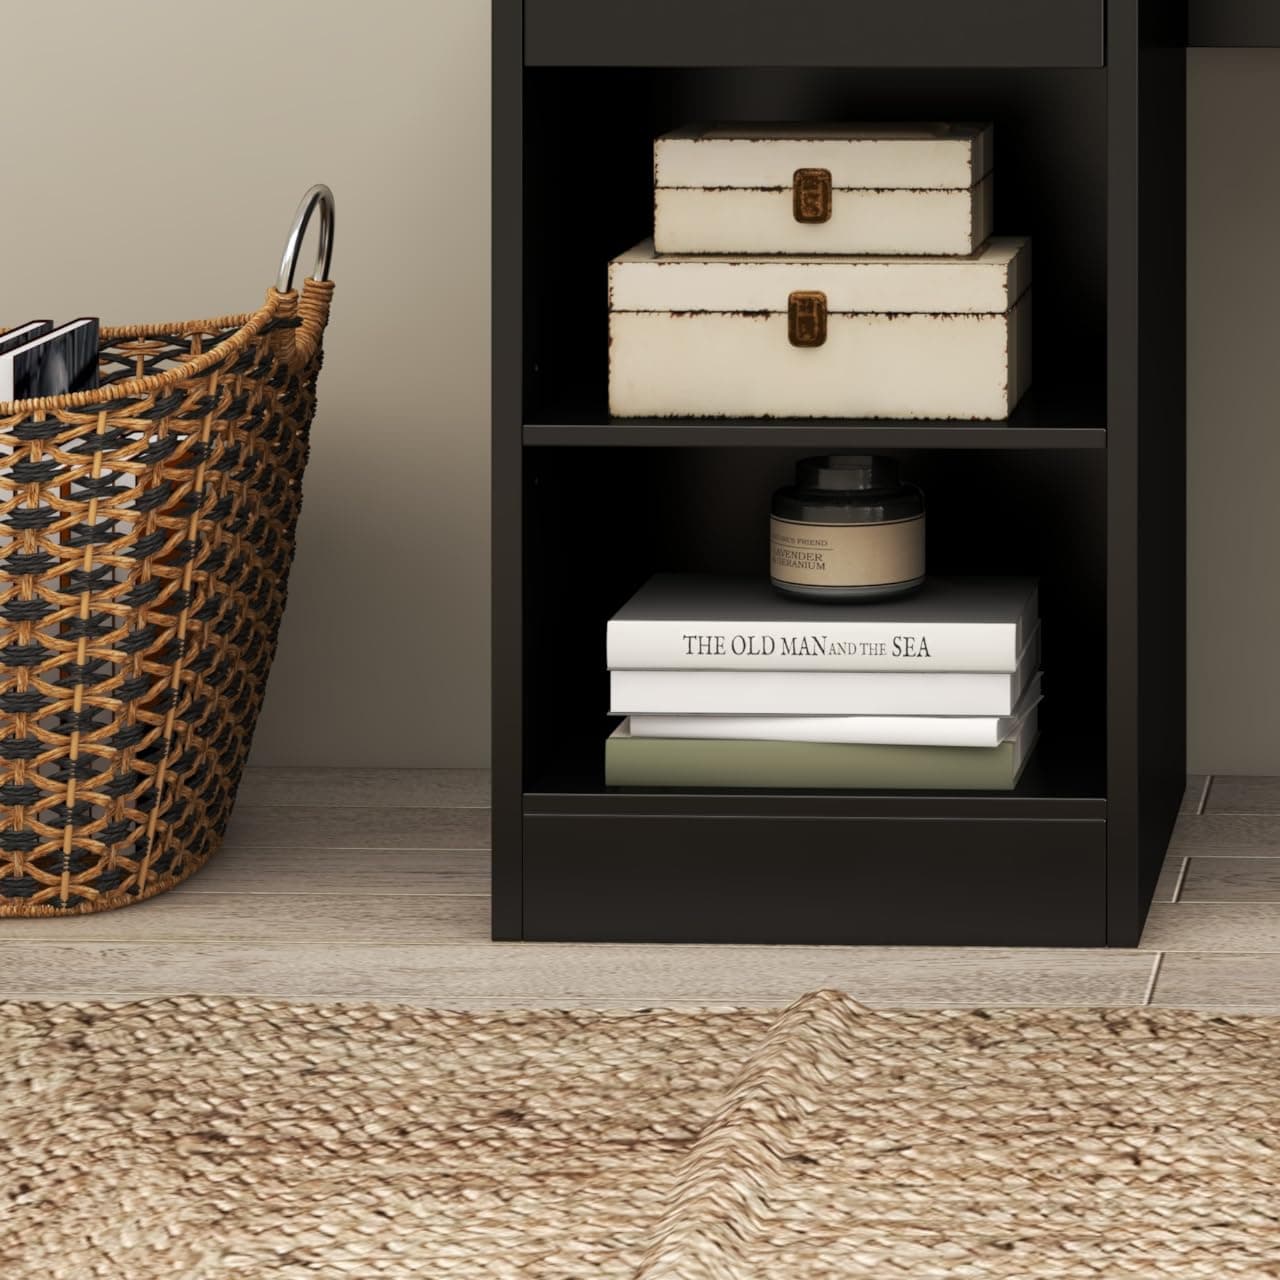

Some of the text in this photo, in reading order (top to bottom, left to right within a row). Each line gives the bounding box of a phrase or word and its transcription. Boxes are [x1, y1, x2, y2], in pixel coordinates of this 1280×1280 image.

[683, 634, 931, 657] THE OLD MAN AND THE SEA
